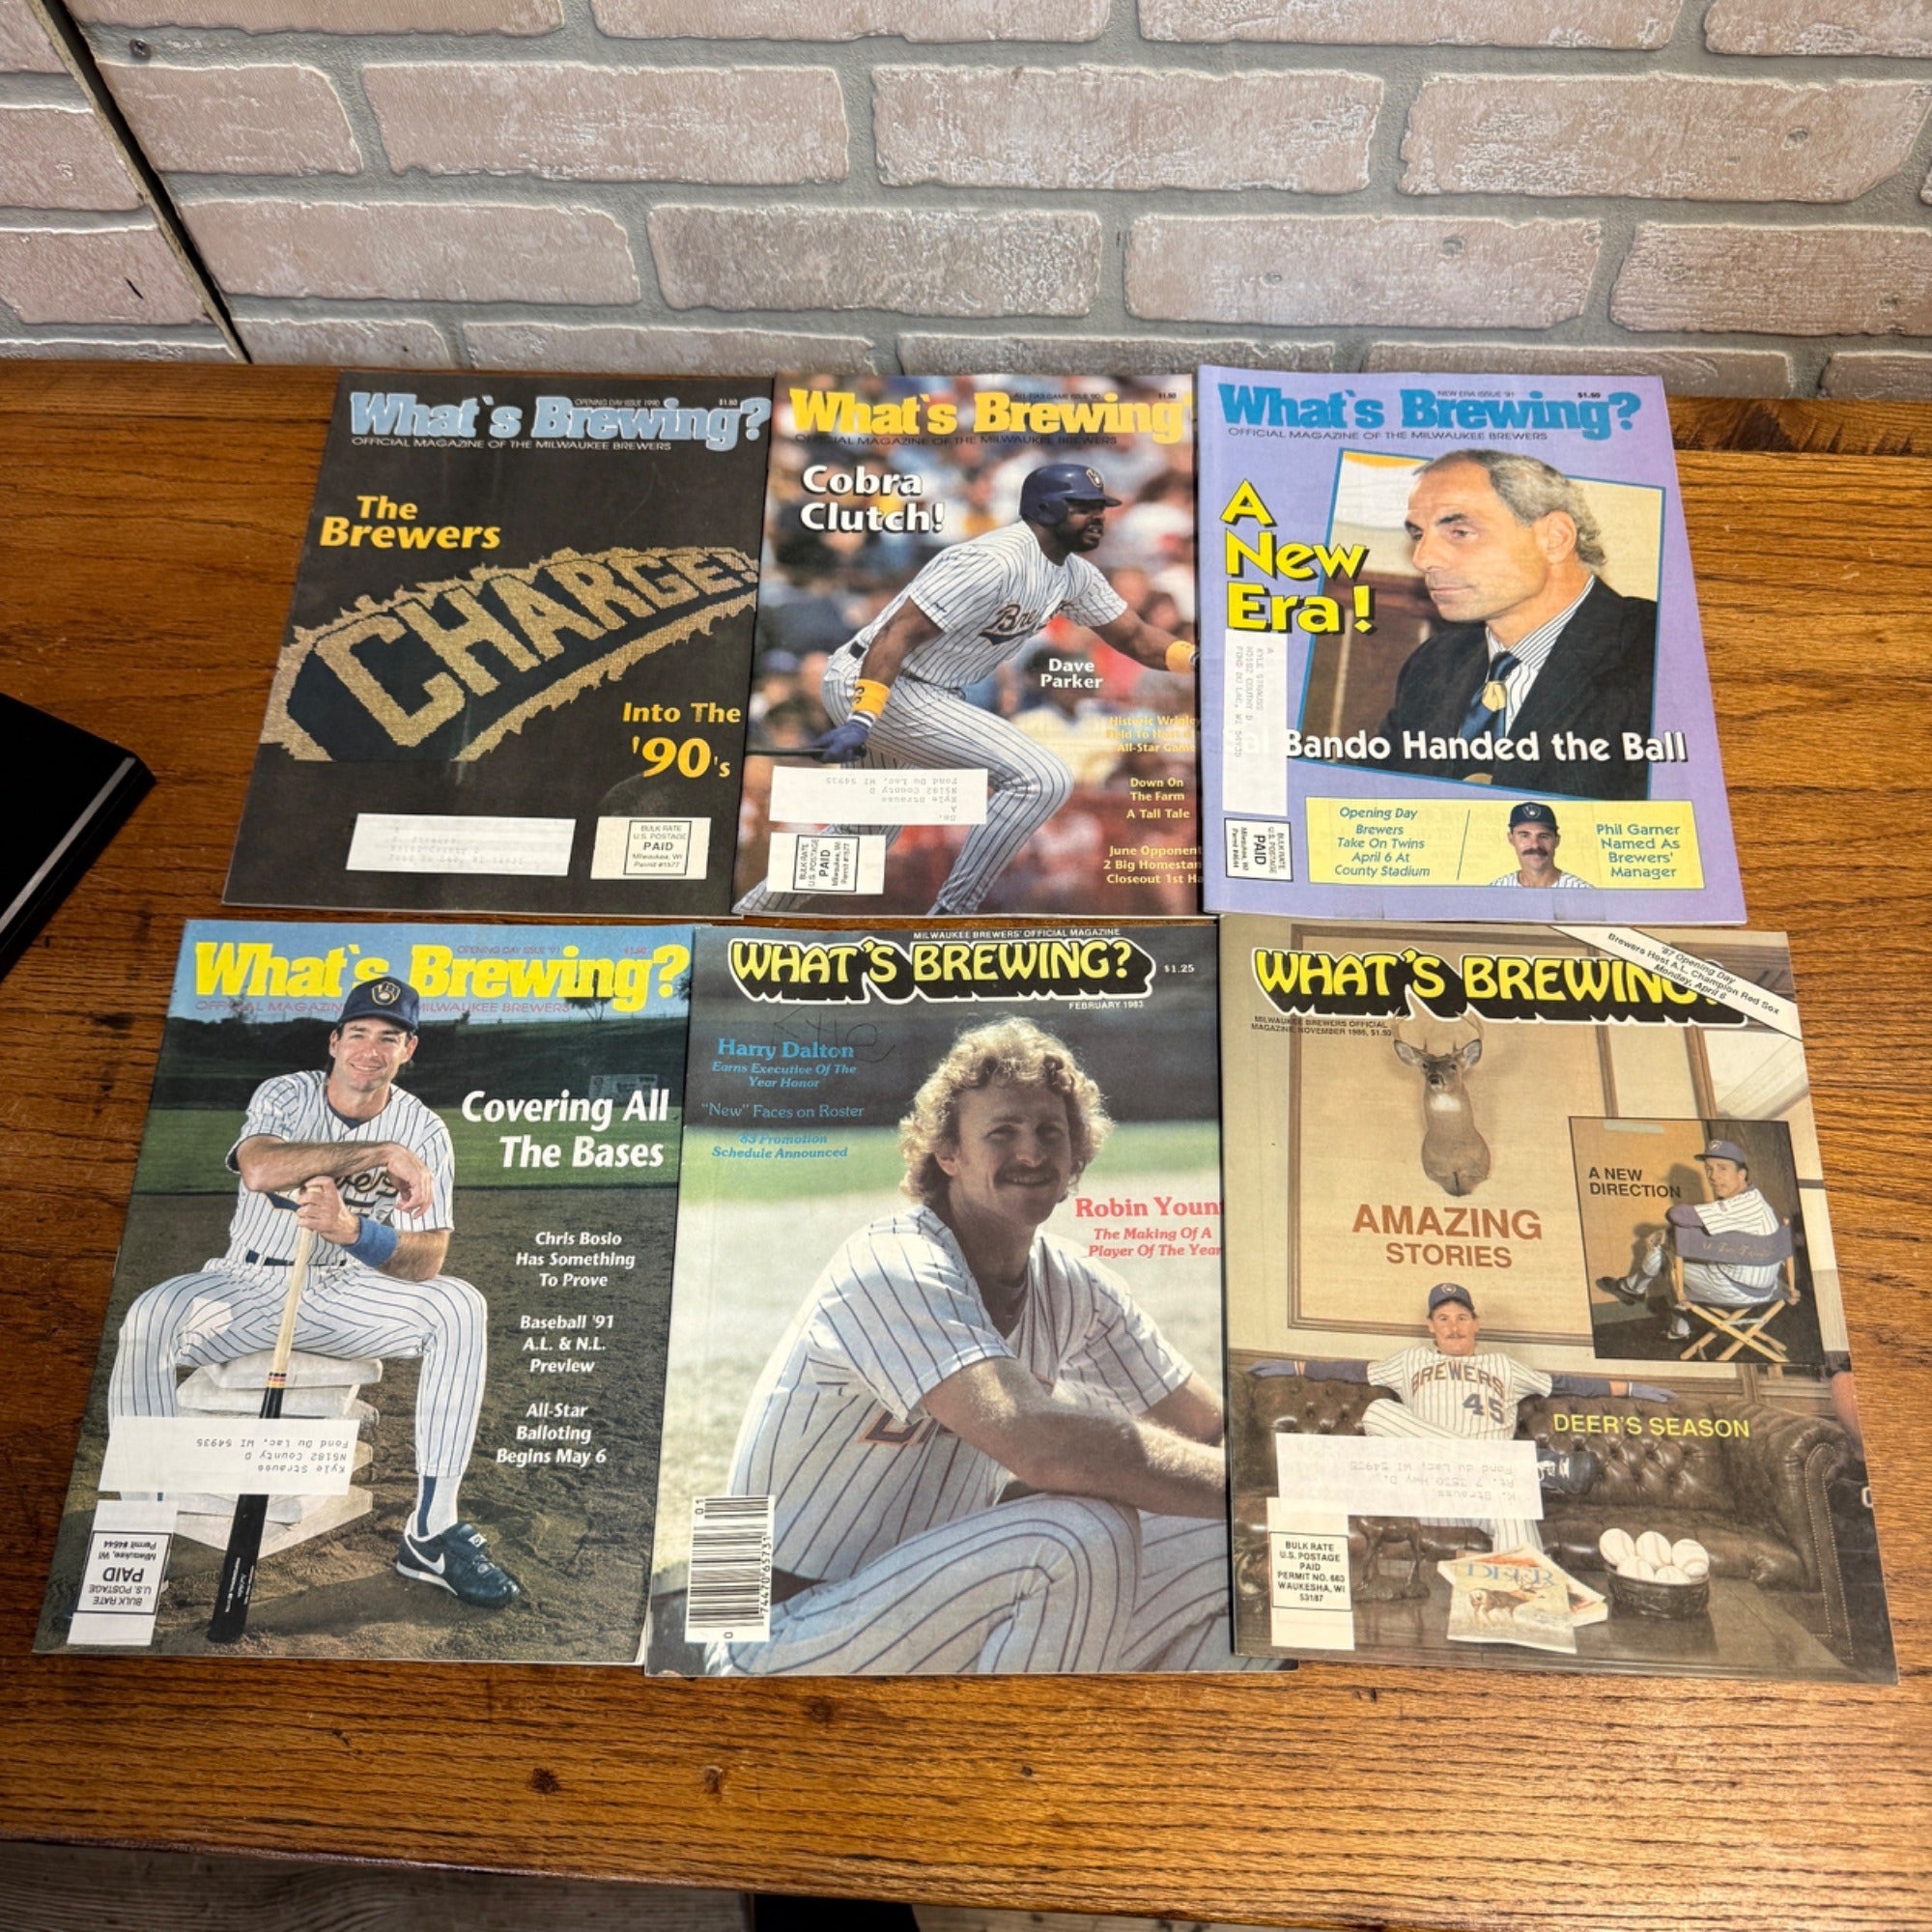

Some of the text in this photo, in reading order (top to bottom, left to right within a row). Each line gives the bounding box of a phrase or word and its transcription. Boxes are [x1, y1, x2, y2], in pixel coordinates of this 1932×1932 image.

[789, 388, 1193, 444] What's Brewing
[1218, 383, 1641, 440] What's Brewing?
[351, 392, 772, 451] What's Brewing?
[858, 435, 1117, 446] MAGAZINE MILWAUKEE BREWERS
[1228, 427, 1284, 438] OFFICIAL
[1289, 430, 1358, 440] MAGAZINE
[1410, 432, 1485, 440] MILWAUKEE
[1489, 432, 1548, 440] BREWERS
[352, 437, 671, 450] OFFICIAL MAGAZINE OF THE MILWAUKEE BREWERS
[802, 465, 923, 497] Cobra
[356, 496, 417, 521] The
[1219, 478, 1278, 526] A
[800, 502, 945, 533] Clutch!
[320, 517, 501, 550] Brewers
[1225, 528, 1370, 581] New
[1227, 582, 1378, 635] Era!
[1049, 658, 1094, 672] Dave
[1040, 673, 1103, 688] Parker
[622, 702, 741, 723] Into The
[1117, 743, 1160, 753] All-Star
[1286, 729, 1688, 763] Bando Handed the Ball
[632, 736, 730, 778] '90's
[1130, 778, 1183, 787] Down On
[1130, 791, 1184, 801] The Farm
[1126, 809, 1190, 818] A Tall Tale
[1340, 807, 1418, 820] Opening Day
[1355, 824, 1404, 835] Brewers
[1596, 823, 1680, 835] Phil Garner
[643, 841, 673, 850] PAID
[1254, 835, 1266, 865] PAID
[1338, 838, 1425, 849] Take On Twins
[1601, 838, 1680, 849] Named As
[1109, 845, 1137, 857] June
[1351, 852, 1409, 864] April 6 At
[1608, 852, 1673, 863] Brewers'
[819, 849, 831, 877] PAID
[1103, 860, 1135, 872] 2 Big
[1106, 874, 1183, 883] Closeout 1st
[1335, 865, 1431, 878] County Stadium
[1610, 867, 1677, 880] Manager
[914, 931, 970, 940] MILWAUKEE
[972, 929, 1022, 939] BREWERS'
[1024, 929, 1068, 938] OFFICIAL
[731, 938, 1135, 987] WHAT'S BREWING?
[1164, 964, 1195, 974] $1.25
[1675, 953, 1737, 984] Opening Day
[409, 944, 691, 1012] Brewing?
[1255, 949, 1719, 1010] WHAT'S BREWIN
[1607, 932, 1780, 1014] Brewers Host Champion Red Sox
[1694, 982, 1719, 999] April
[268, 1002, 345, 1012] MAGAZIN
[502, 1003, 570, 1012] BREWERS
[1068, 1000, 1144, 1010] FEBRUARY 1983
[1254, 1016, 1303, 1026] MILWAUKEE
[1297, 1026, 1346, 1036] NOVEMBER
[718, 1038, 854, 1061] Harry Dalton
[711, 1061, 857, 1076] Earns Executive Of The
[749, 1076, 820, 1088] Year Honor
[462, 1089, 669, 1128] Covering All
[753, 1104, 865, 1119] Faces on Roster
[758, 1133, 828, 1145] Promotion
[499, 1135, 665, 1169] The Bases
[711, 1147, 848, 1158] Schedule Announced
[1588, 1167, 1642, 1181] A NEW
[1590, 1181, 1682, 1199] DIRECTION
[1075, 1197, 1149, 1217] Robin
[1352, 1204, 1543, 1240] AMAZING
[535, 1232, 622, 1245] Chris Bosio
[1094, 1227, 1212, 1241] The Making Of A
[1089, 1244, 1222, 1258] Player Of The Year
[1385, 1242, 1513, 1268] STORIES
[516, 1252, 636, 1269] Has Something
[539, 1273, 609, 1287] To Prove
[520, 1314, 614, 1329] Baseball '91
[523, 1337, 607, 1350] A.L. & N.L.
[529, 1358, 595, 1373] Preview
[1411, 1360, 1505, 1399] BREWERS
[526, 1403, 589, 1418] All-Star
[1462, 1393, 1505, 1424] 45
[1553, 1413, 1750, 1437] DEER'S SEASON
[516, 1425, 592, 1443] Balloting
[497, 1449, 607, 1467] Begins May 6
[1286, 1541, 1334, 1551] BULK RATE
[1298, 1552, 1341, 1562] POSTAGE
[102, 1567, 144, 1582] PAID
[1277, 1572, 1310, 1580] PERMIT
[1466, 1563, 1555, 1586] DEER
[1278, 1581, 1332, 1593] WAUKESHA,
[1299, 1593, 1323, 1602] 53187
